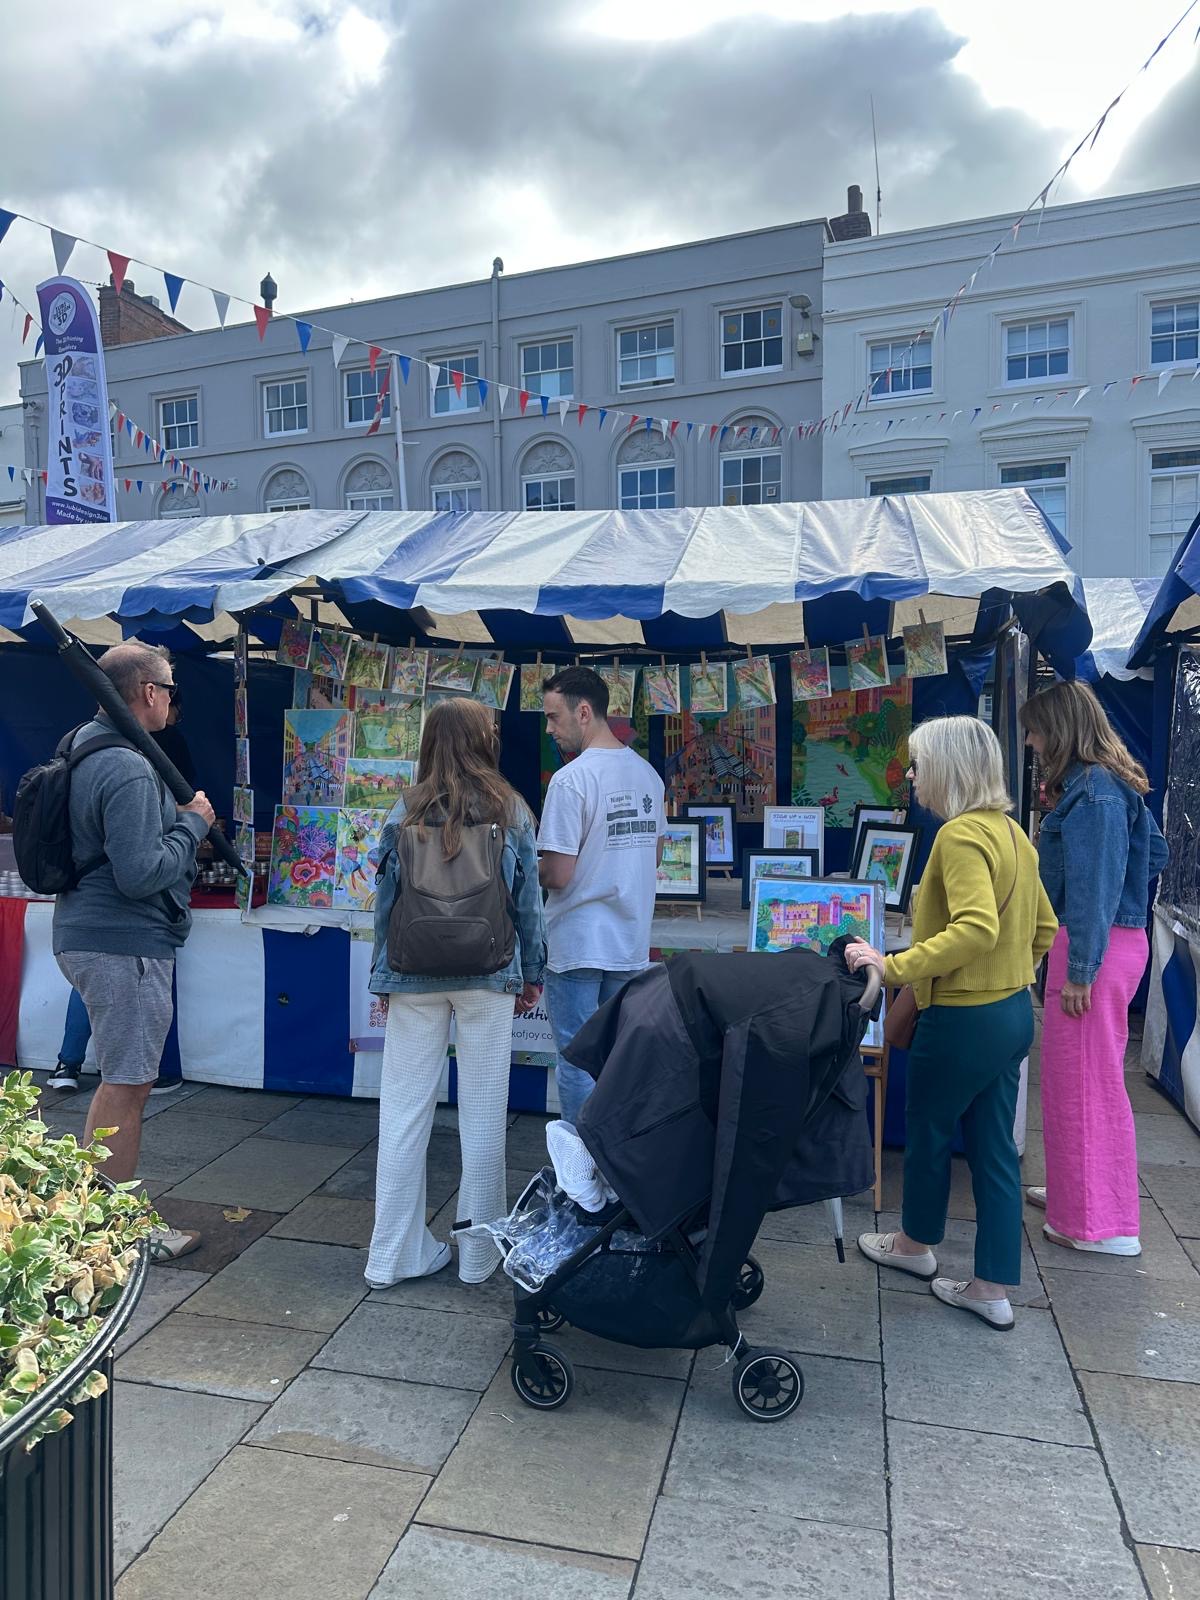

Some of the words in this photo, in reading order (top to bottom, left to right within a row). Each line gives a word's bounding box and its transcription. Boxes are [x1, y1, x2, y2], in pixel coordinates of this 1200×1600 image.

[57, 312, 68, 326] 3D
[53, 355, 73, 387] 3D
[58, 382, 78, 497] PRINTS
[56, 509, 75, 519] Made
[75, 515, 84, 523] by
